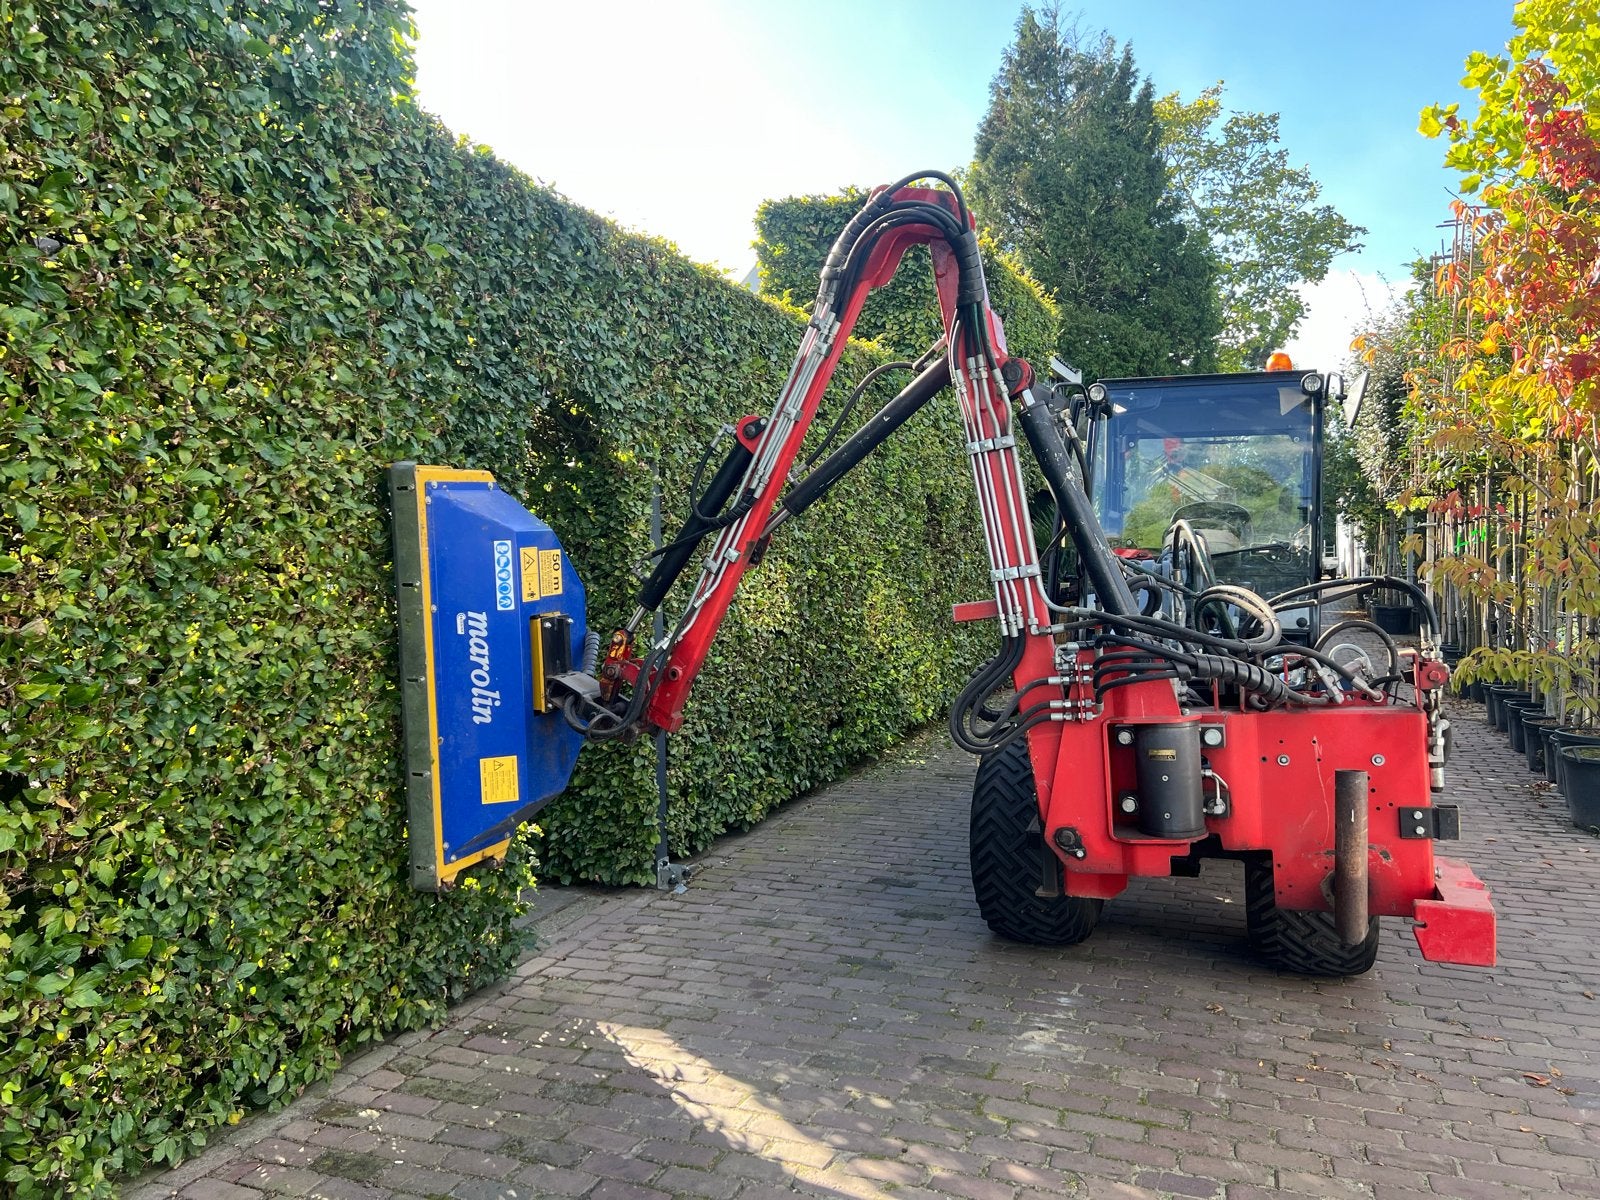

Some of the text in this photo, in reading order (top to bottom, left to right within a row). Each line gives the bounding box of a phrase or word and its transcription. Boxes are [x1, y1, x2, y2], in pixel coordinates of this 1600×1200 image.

[552, 554, 561, 590] 50 m
[467, 611, 501, 725] marolin
